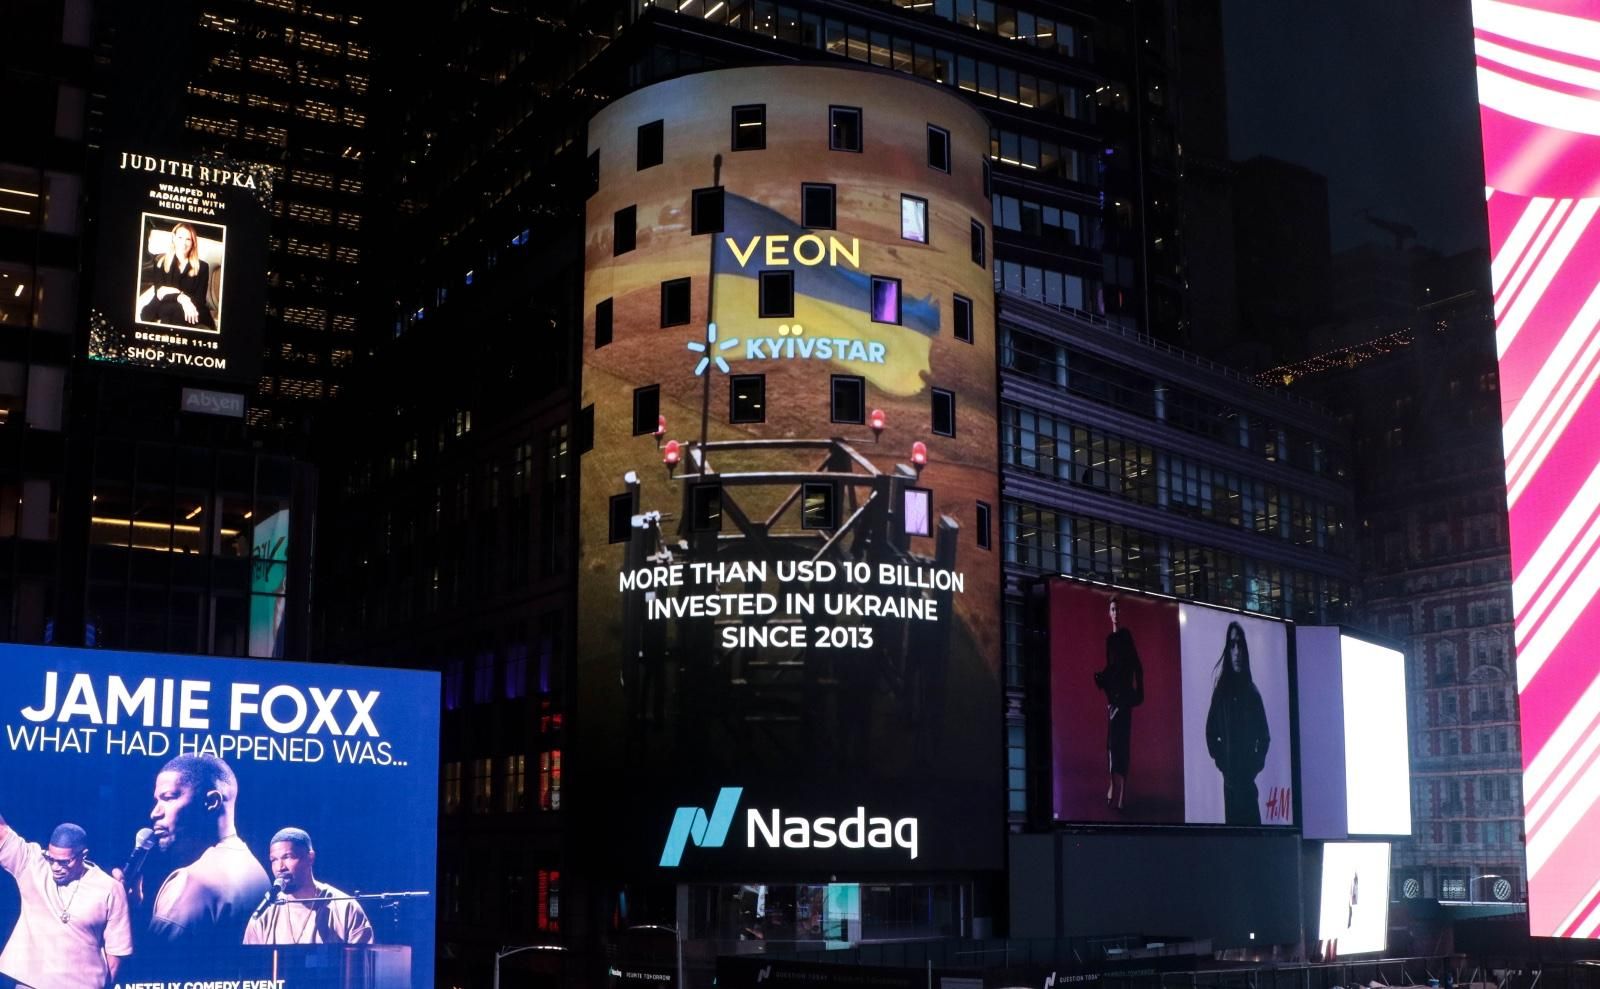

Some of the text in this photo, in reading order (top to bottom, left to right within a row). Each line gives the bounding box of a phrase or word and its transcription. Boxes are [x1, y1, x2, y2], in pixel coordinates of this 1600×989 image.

[120, 152, 257, 189] JUDITH RIPKA
[149, 190, 225, 209] RADIANCE WITH
[158, 183, 217, 199] WRAPPED IN
[158, 201, 215, 216] HEIDI RIPKA
[725, 234, 860, 268] VEON
[134, 331, 188, 345] DECEMBER
[127, 346, 226, 370] SHOP JTV.COM
[186, 392, 240, 411] Absen
[619, 561, 965, 593] MORE THAN USD 10 BILLION
[647, 593, 938, 621] INVESTED IN UKRAINE
[721, 627, 874, 649] SINCE 2013
[20, 671, 380, 737] JAMIE FOXX
[6, 725, 409, 766] WHAT HAD HAPPENED WAS...
[1265, 786, 1291, 821] H&M
[747, 806, 918, 860] Nasdaq
